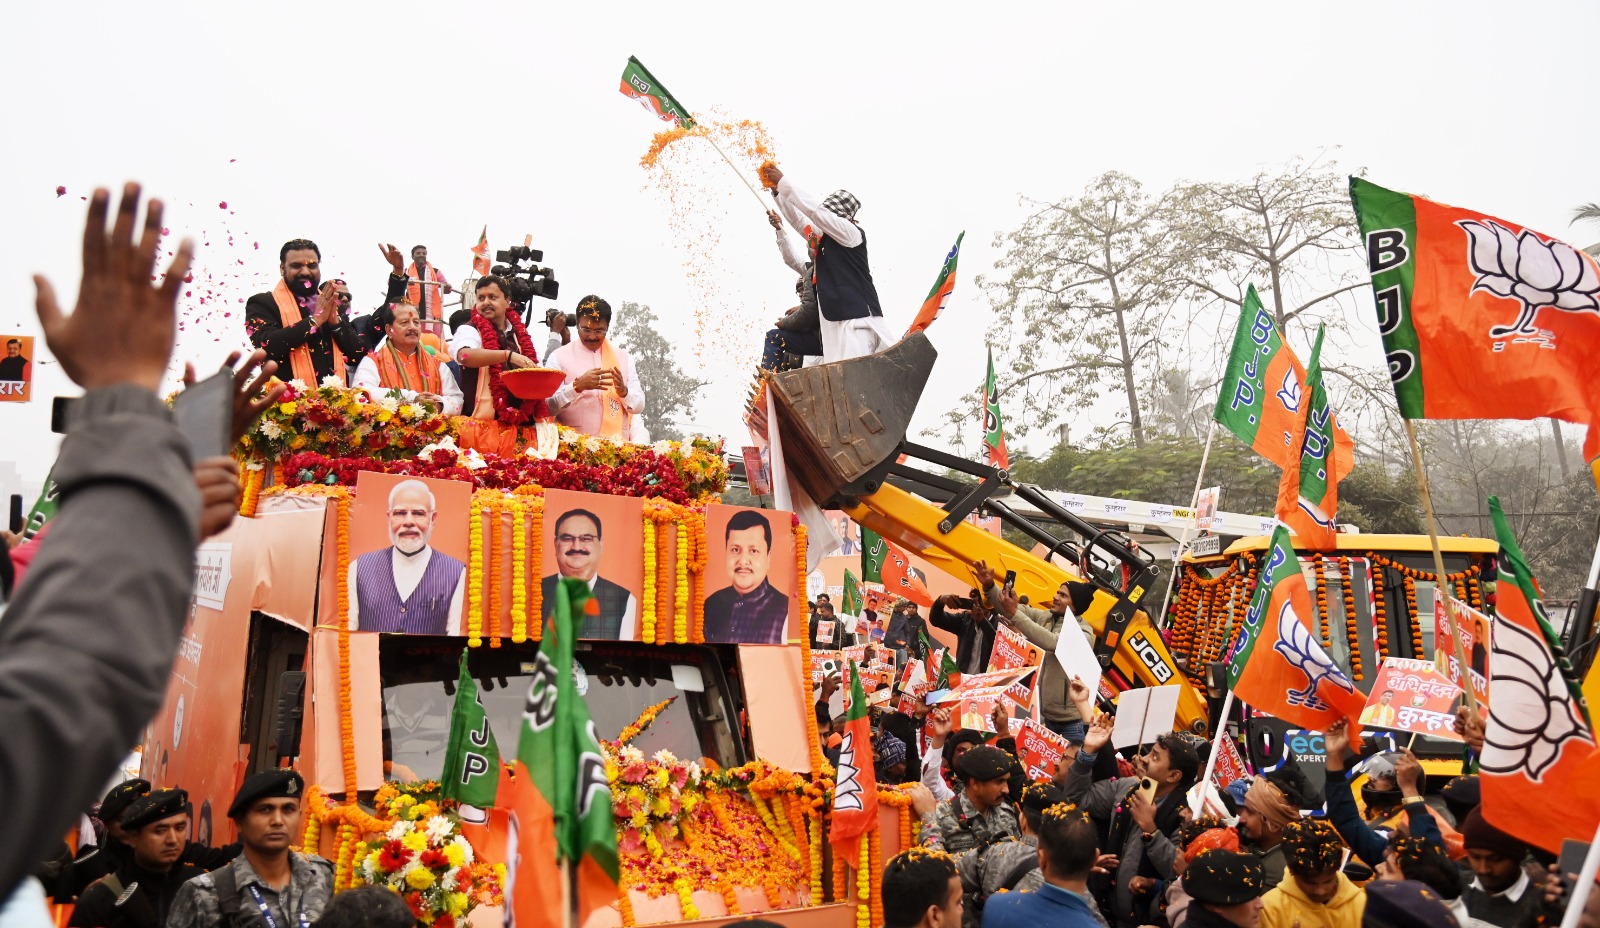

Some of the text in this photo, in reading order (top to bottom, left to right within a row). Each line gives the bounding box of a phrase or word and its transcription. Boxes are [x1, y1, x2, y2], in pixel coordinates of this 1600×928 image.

[1366, 228, 1415, 384] BJP
[1105, 504, 1126, 512] कुम्हरार
[1129, 634, 1172, 683] JCB
[1386, 672, 1460, 699] अभिनंदन
[1397, 705, 1456, 731] कुम्हर
[1291, 736, 1325, 754] ec
[1295, 755, 1327, 763] XPERT
